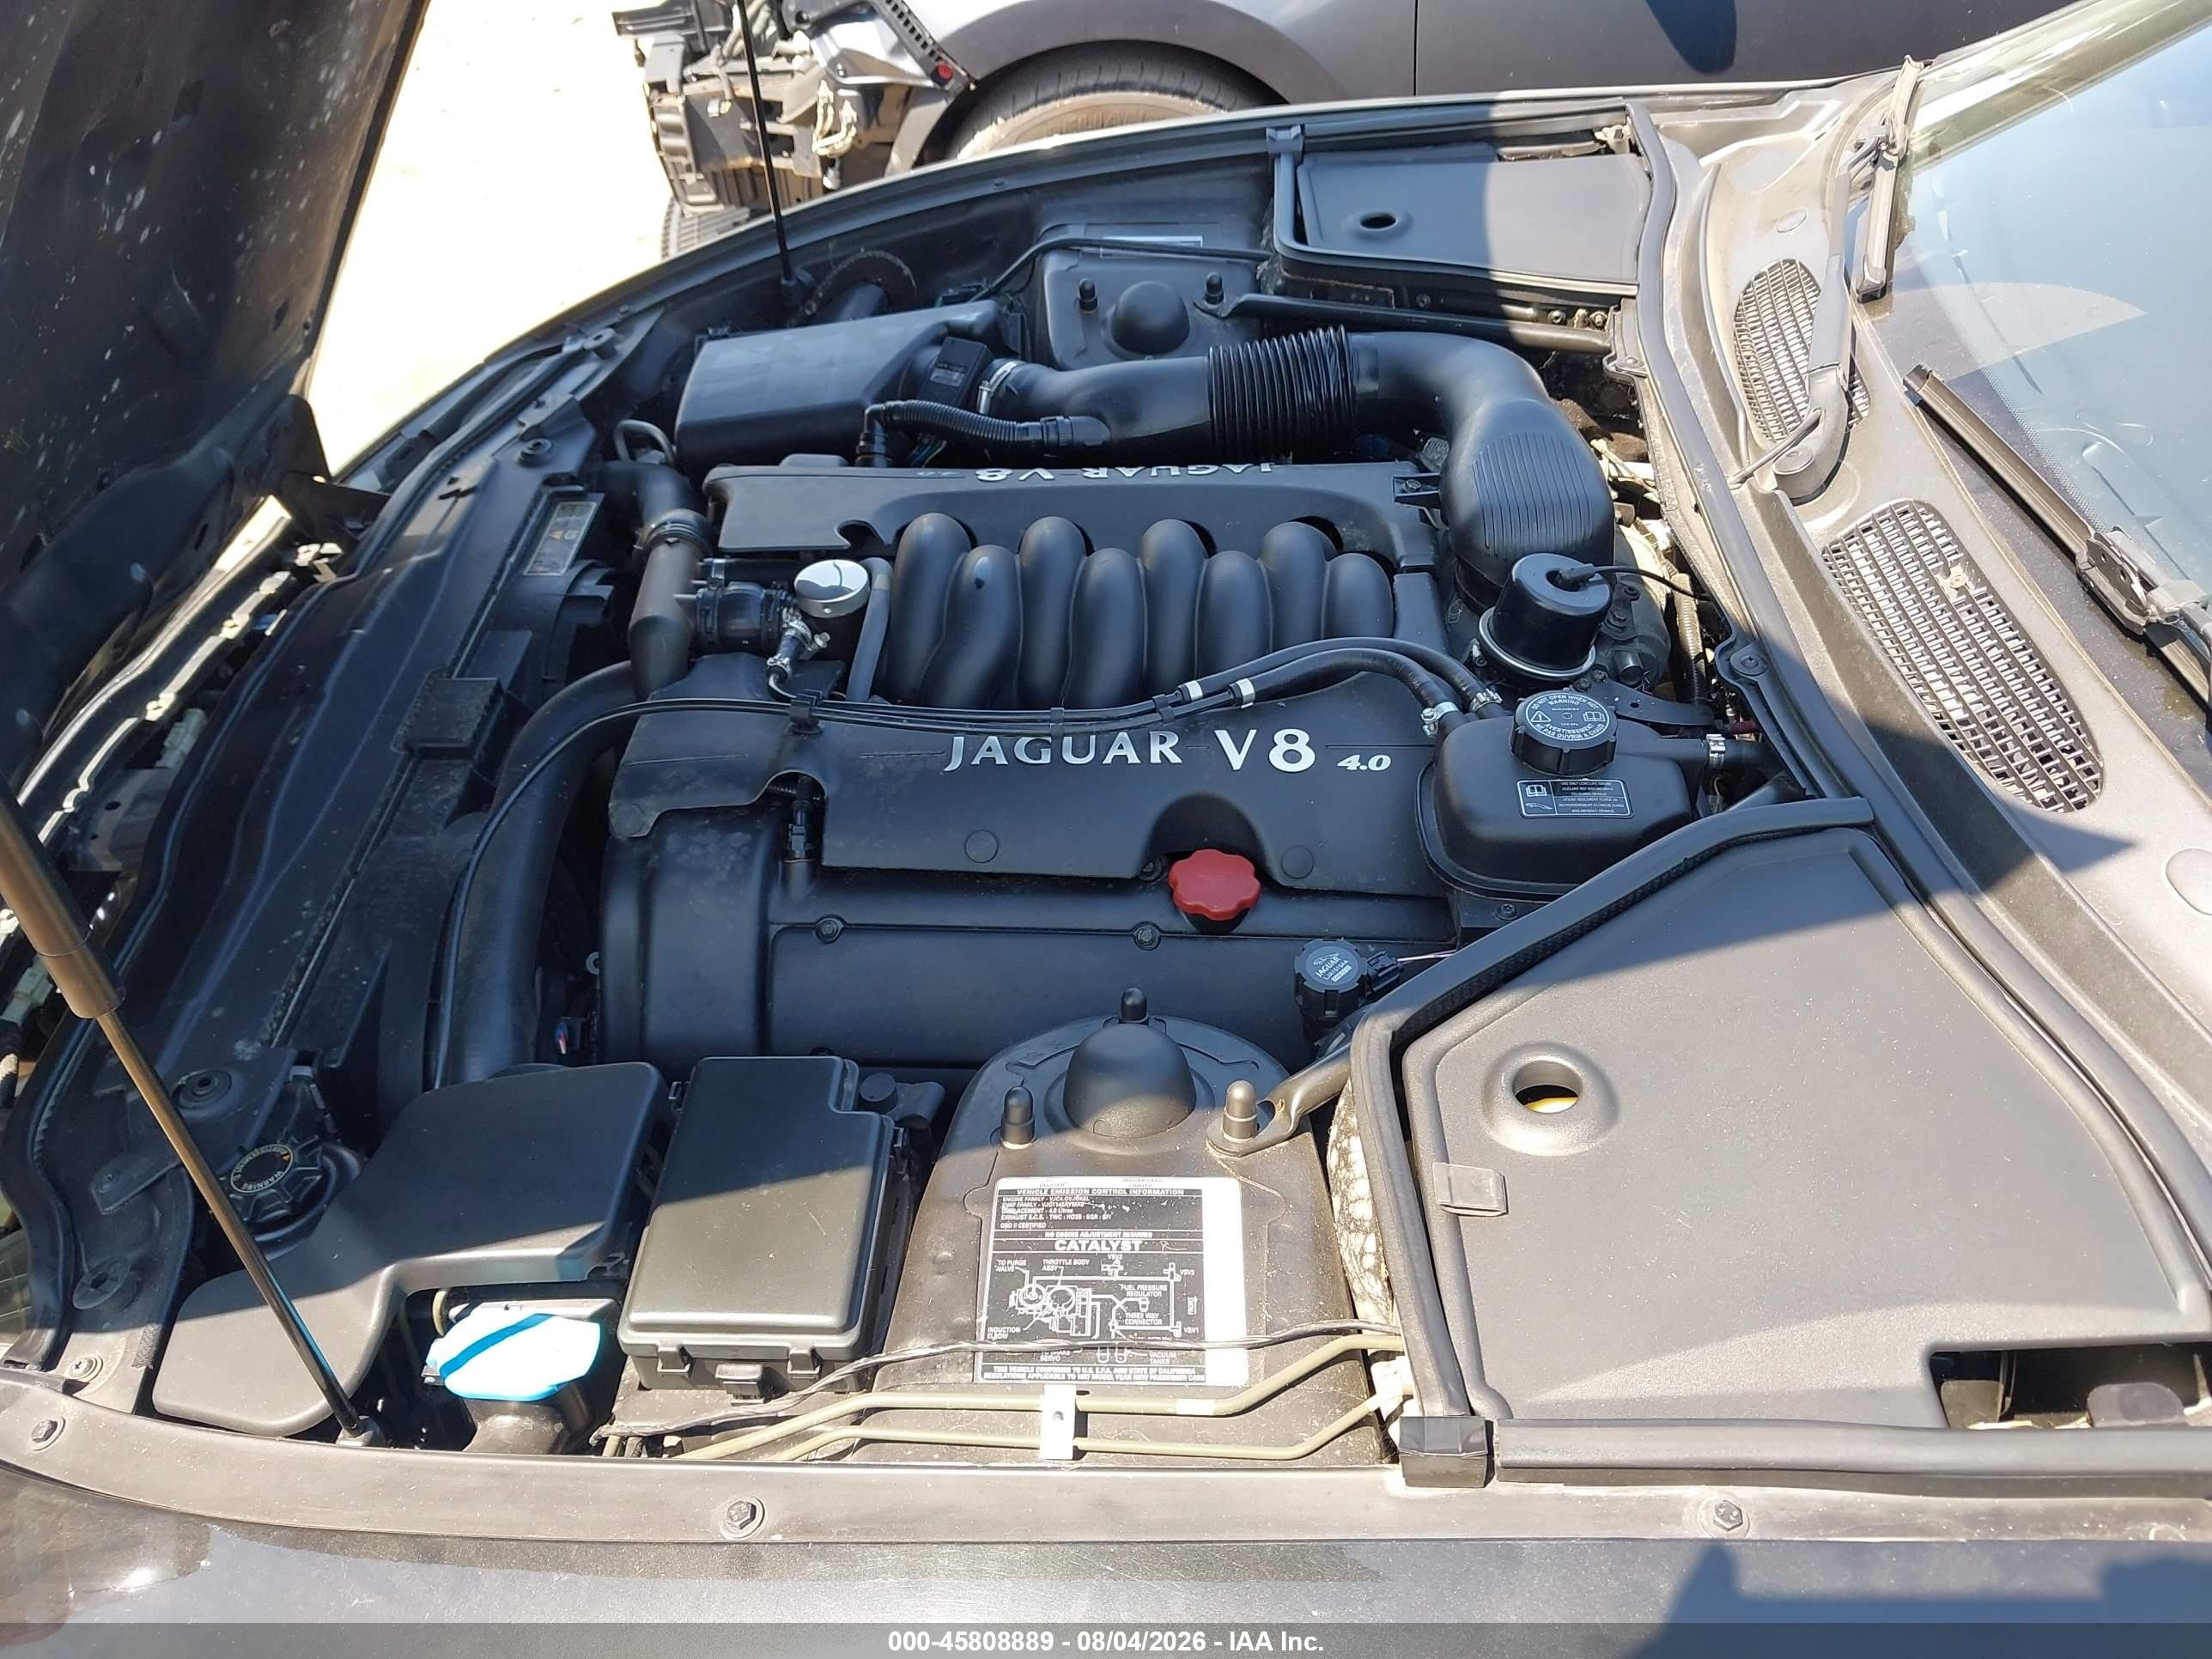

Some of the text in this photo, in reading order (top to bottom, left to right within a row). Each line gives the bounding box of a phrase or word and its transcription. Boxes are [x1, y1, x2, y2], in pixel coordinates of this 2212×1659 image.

[975, 468, 1054, 481] V8
[1082, 463, 1276, 478] JAGUAR
[1588, 701, 1600, 709] HOT
[1545, 723, 1595, 733] AVERTISSEMENT
[1589, 723, 1605, 735] CHAUD
[944, 728, 1391, 773] JAGUAR V8 4.0
[1315, 956, 1341, 977] JAGUAR
[1054, 1239, 1143, 1251] CATALYST
